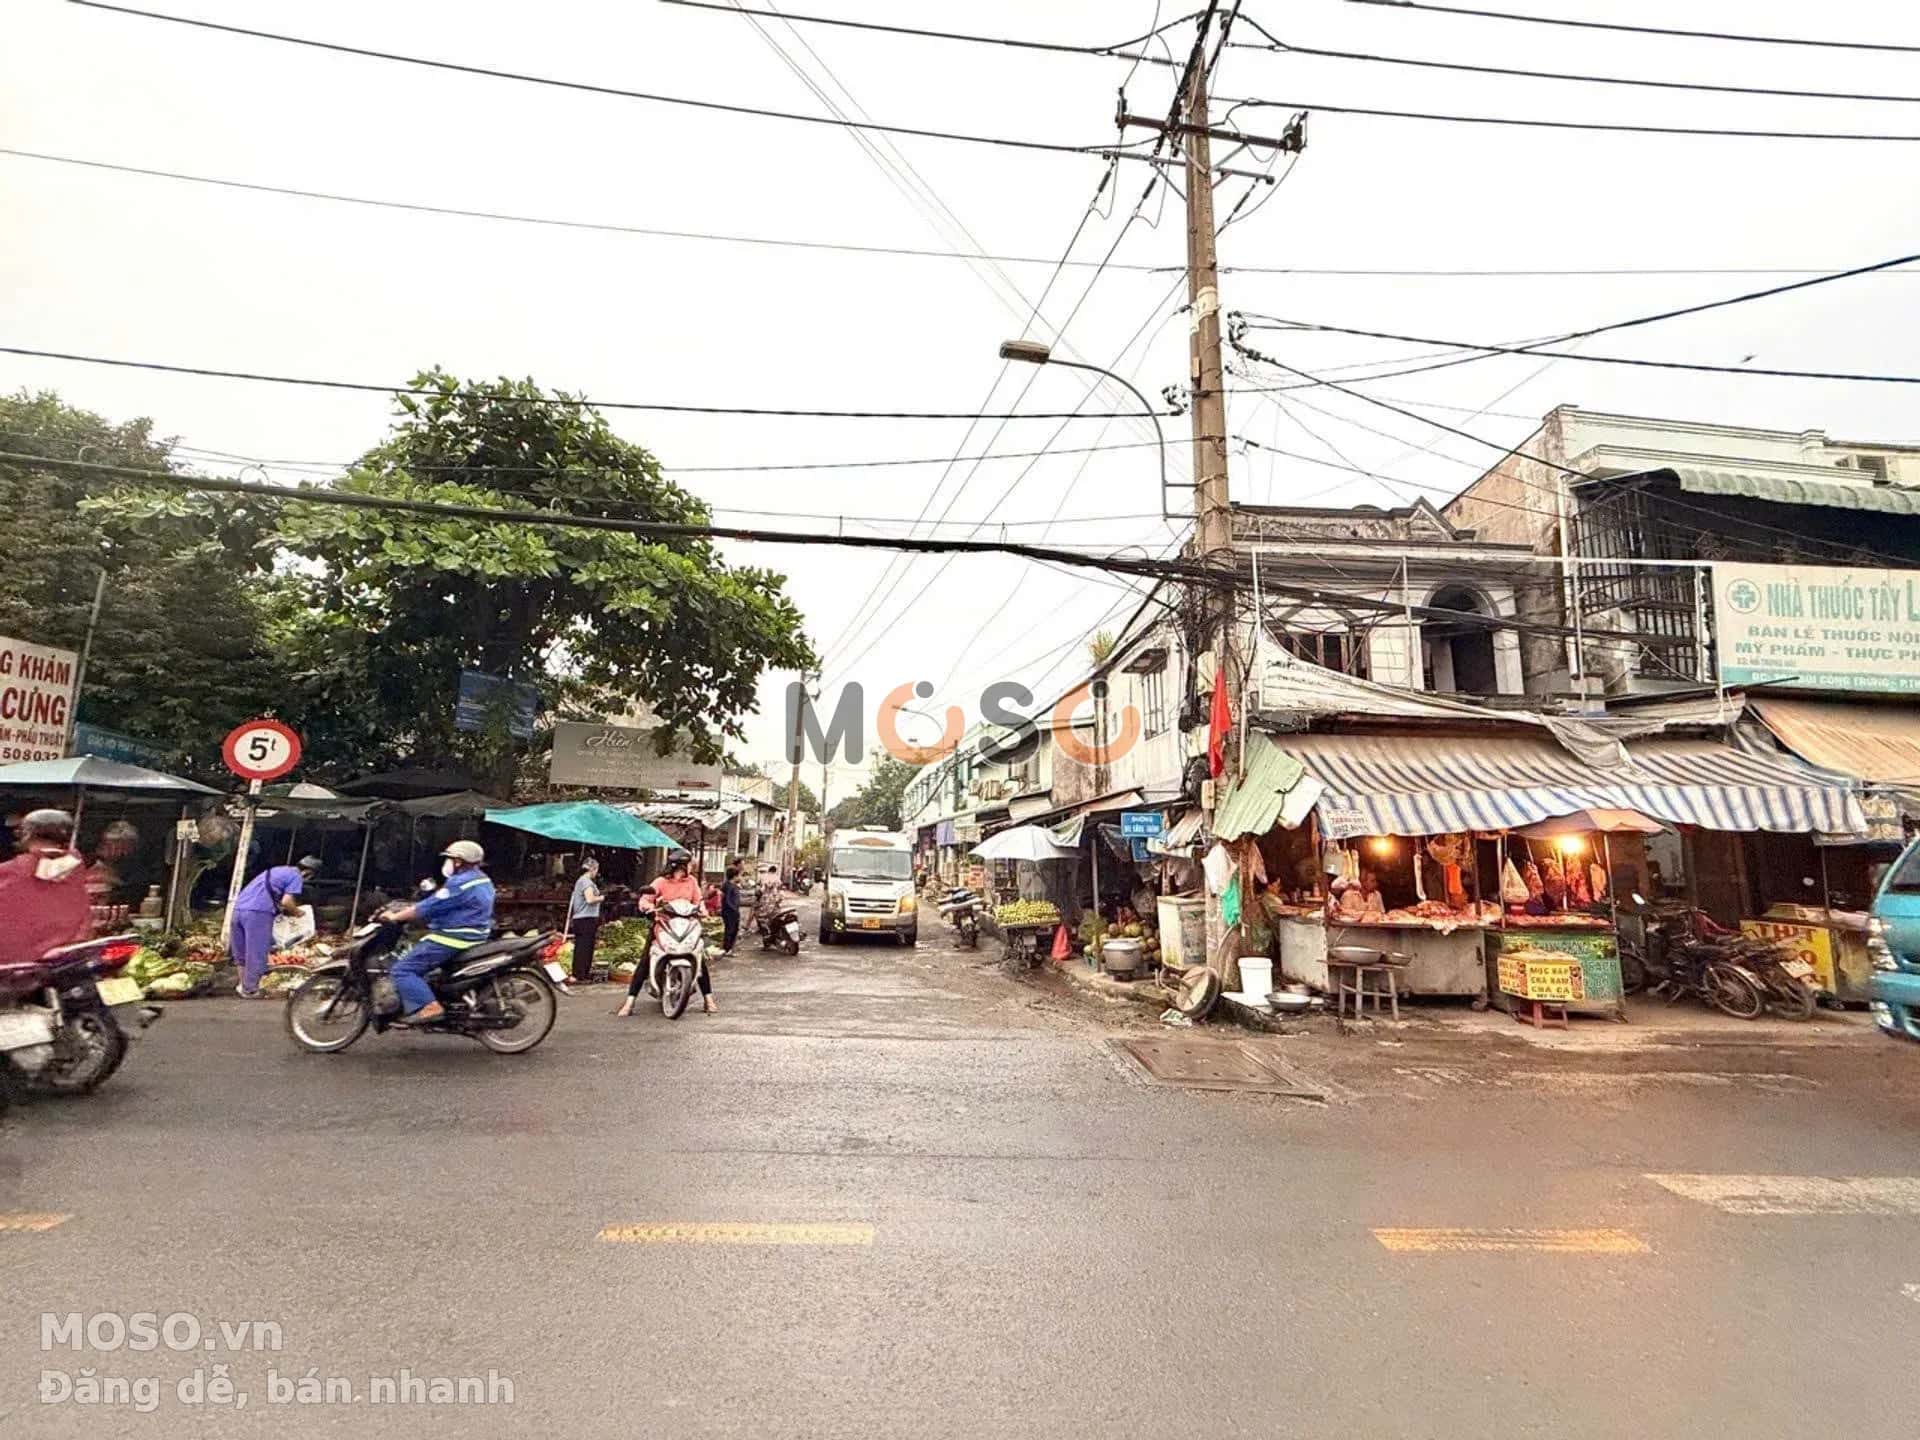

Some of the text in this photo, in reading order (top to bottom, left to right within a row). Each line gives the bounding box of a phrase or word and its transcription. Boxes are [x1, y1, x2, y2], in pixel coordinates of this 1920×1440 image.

[1768, 577, 1803, 617] NHÀ
[1808, 575, 1864, 620] THUỐC
[1869, 581, 1901, 621] TÂY
[19, 654, 70, 686] KHÁM
[2, 686, 67, 726] CƯNG
